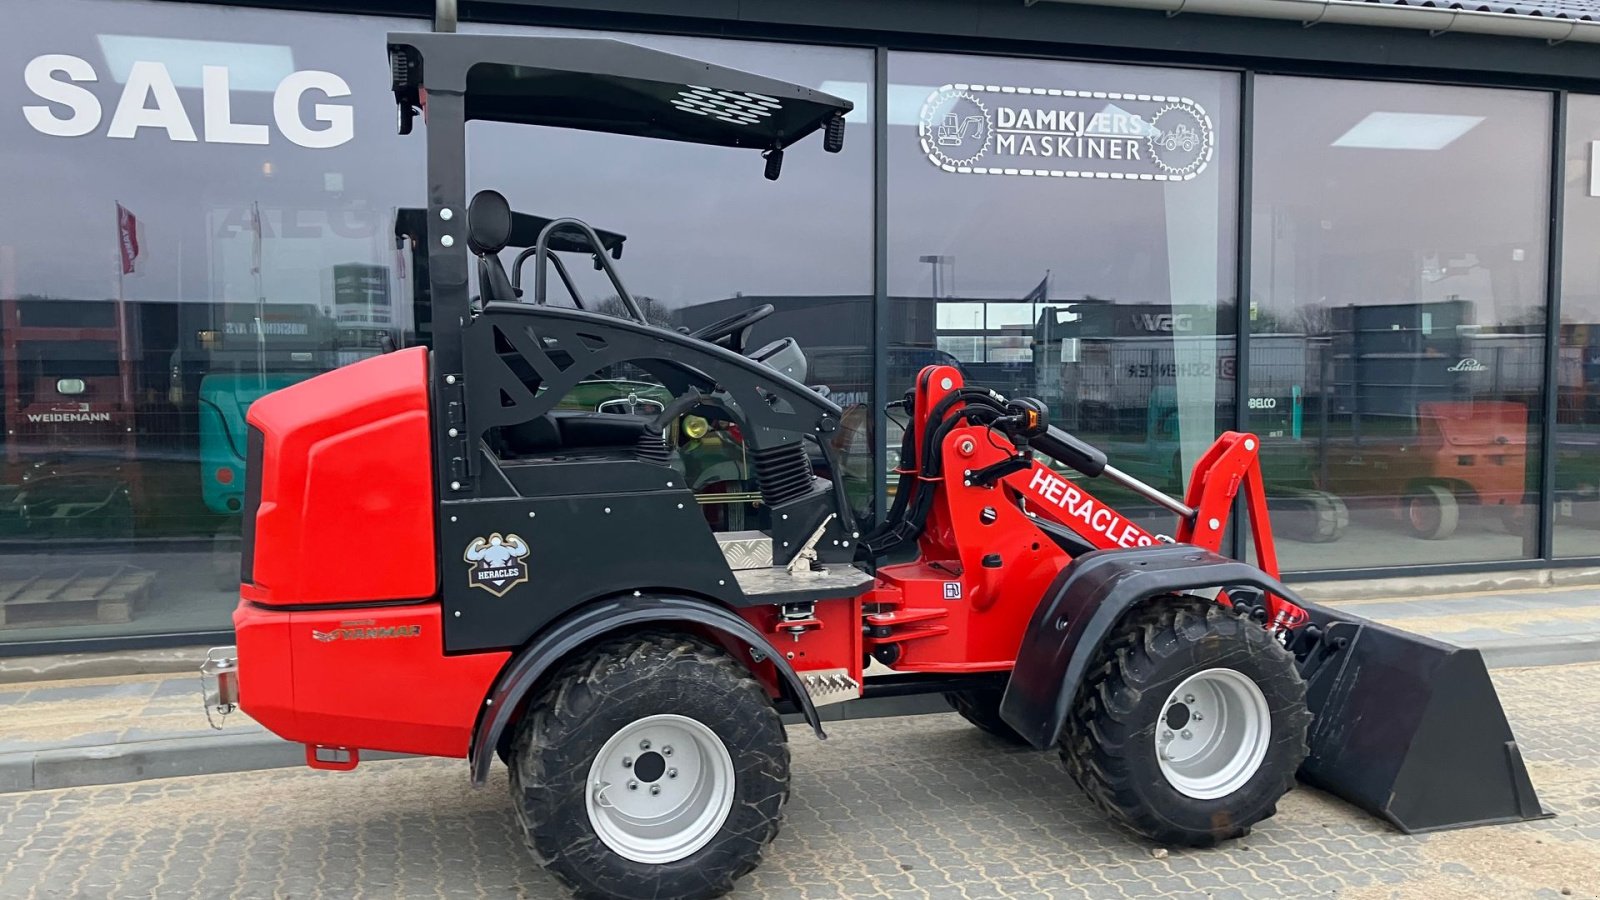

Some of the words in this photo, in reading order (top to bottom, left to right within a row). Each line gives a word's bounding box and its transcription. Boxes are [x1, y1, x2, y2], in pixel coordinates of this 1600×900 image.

[22, 54, 354, 148] SALG
[997, 107, 1142, 137] DAMKJÆRS
[996, 134, 1141, 160] MASKINER
[1447, 358, 1487, 372] Linde
[28, 413, 110, 422] WEIDEMANN
[478, 568, 519, 580] HERACLES
